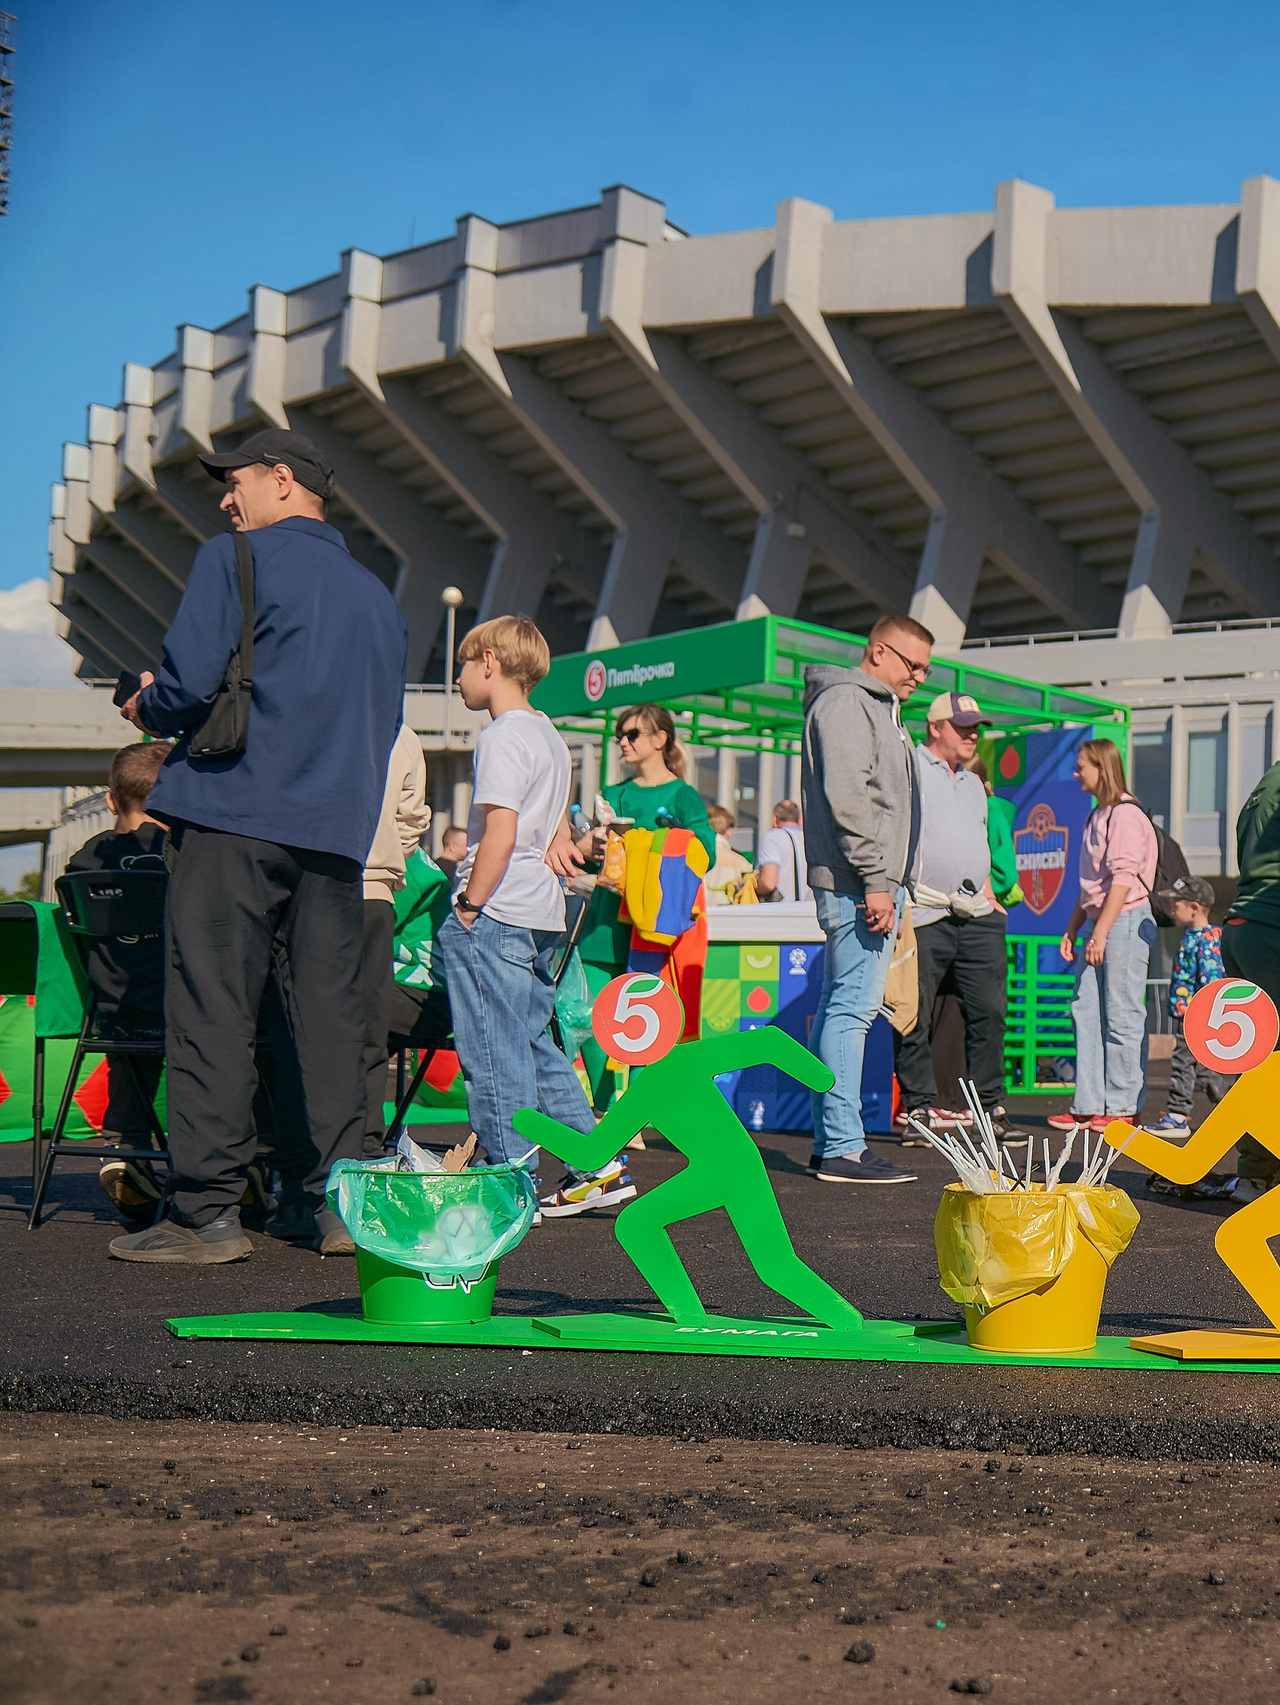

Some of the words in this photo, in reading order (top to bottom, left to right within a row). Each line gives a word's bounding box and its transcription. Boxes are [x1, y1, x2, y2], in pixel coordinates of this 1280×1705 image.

[607, 661, 675, 688] Пятёрочка
[612, 974, 665, 1053] 5
[1205, 980, 1262, 1060] 5
[674, 1326, 820, 1338] БУМАГА
